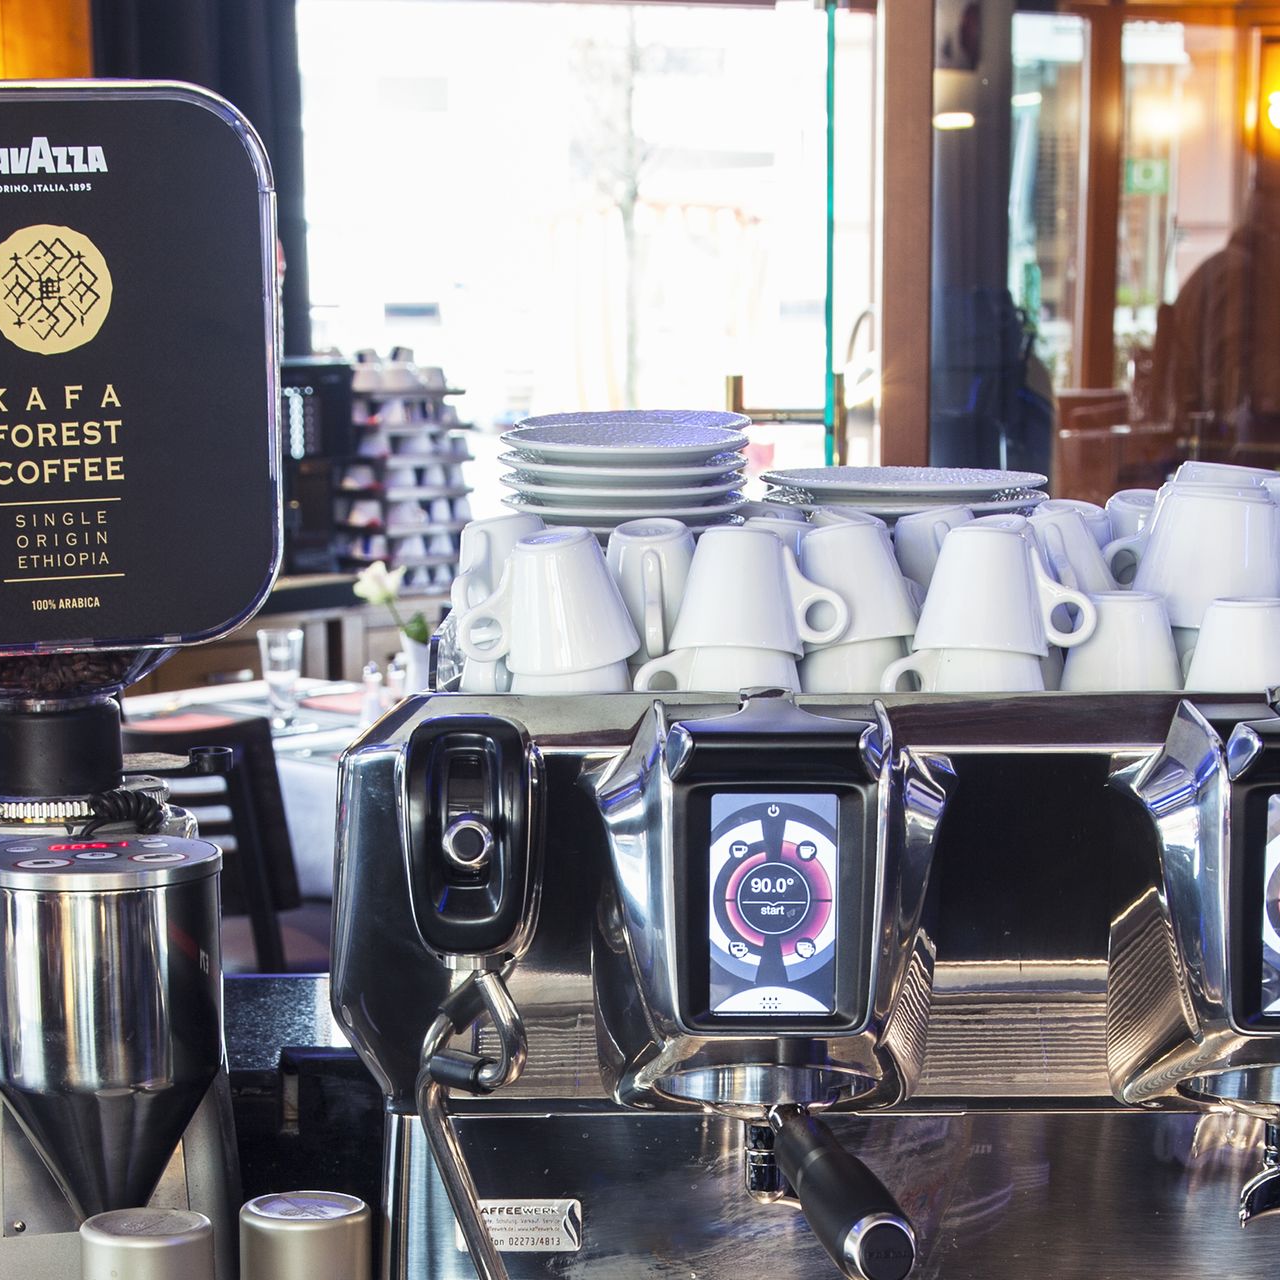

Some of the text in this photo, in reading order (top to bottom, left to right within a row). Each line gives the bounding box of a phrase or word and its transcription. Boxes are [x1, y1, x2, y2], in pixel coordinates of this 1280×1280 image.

[15, 511, 107, 528] SINGLE
[16, 531, 108, 548] ORIGIN
[18, 552, 109, 569] ETHIOPIA
[31, 597, 101, 611] 100% ARABICA
[750, 877, 794, 894] 90.0°
[760, 905, 785, 916] start
[480, 1207, 559, 1216] AFFEEWERK
[508, 1236, 561, 1247] 02273/4813
